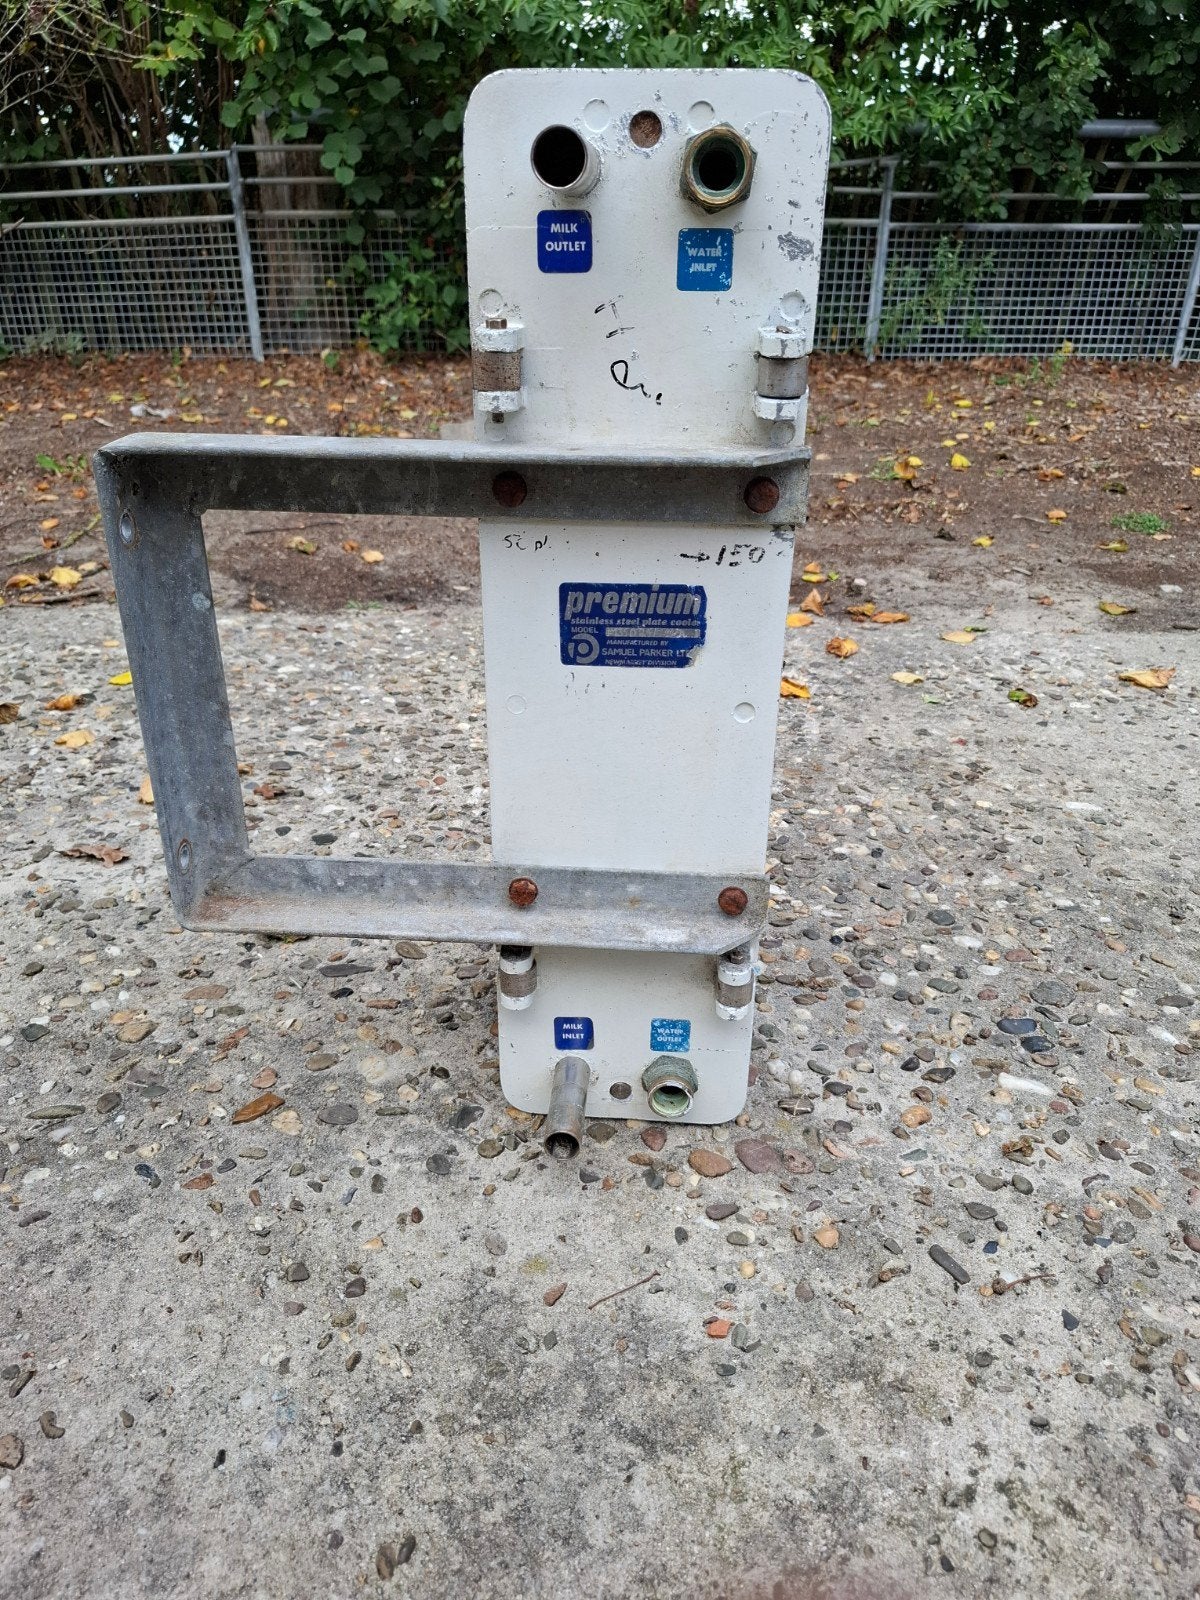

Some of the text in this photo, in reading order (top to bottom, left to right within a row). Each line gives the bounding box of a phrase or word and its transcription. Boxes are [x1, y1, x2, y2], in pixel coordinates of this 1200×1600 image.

[550, 222, 578, 233] MILK
[545, 241, 587, 252] OUTLET
[687, 246, 722, 257] WATER
[690, 262, 718, 272] INLET
[564, 584, 701, 621] premium
[570, 616, 614, 626] stainless
[616, 617, 640, 626] steel
[642, 617, 667, 628] plate
[570, 626, 599, 634] MODEL
[601, 648, 637, 657] SAMUEL
[639, 648, 673, 657] PARKER
[657, 1027, 684, 1035] WATER
